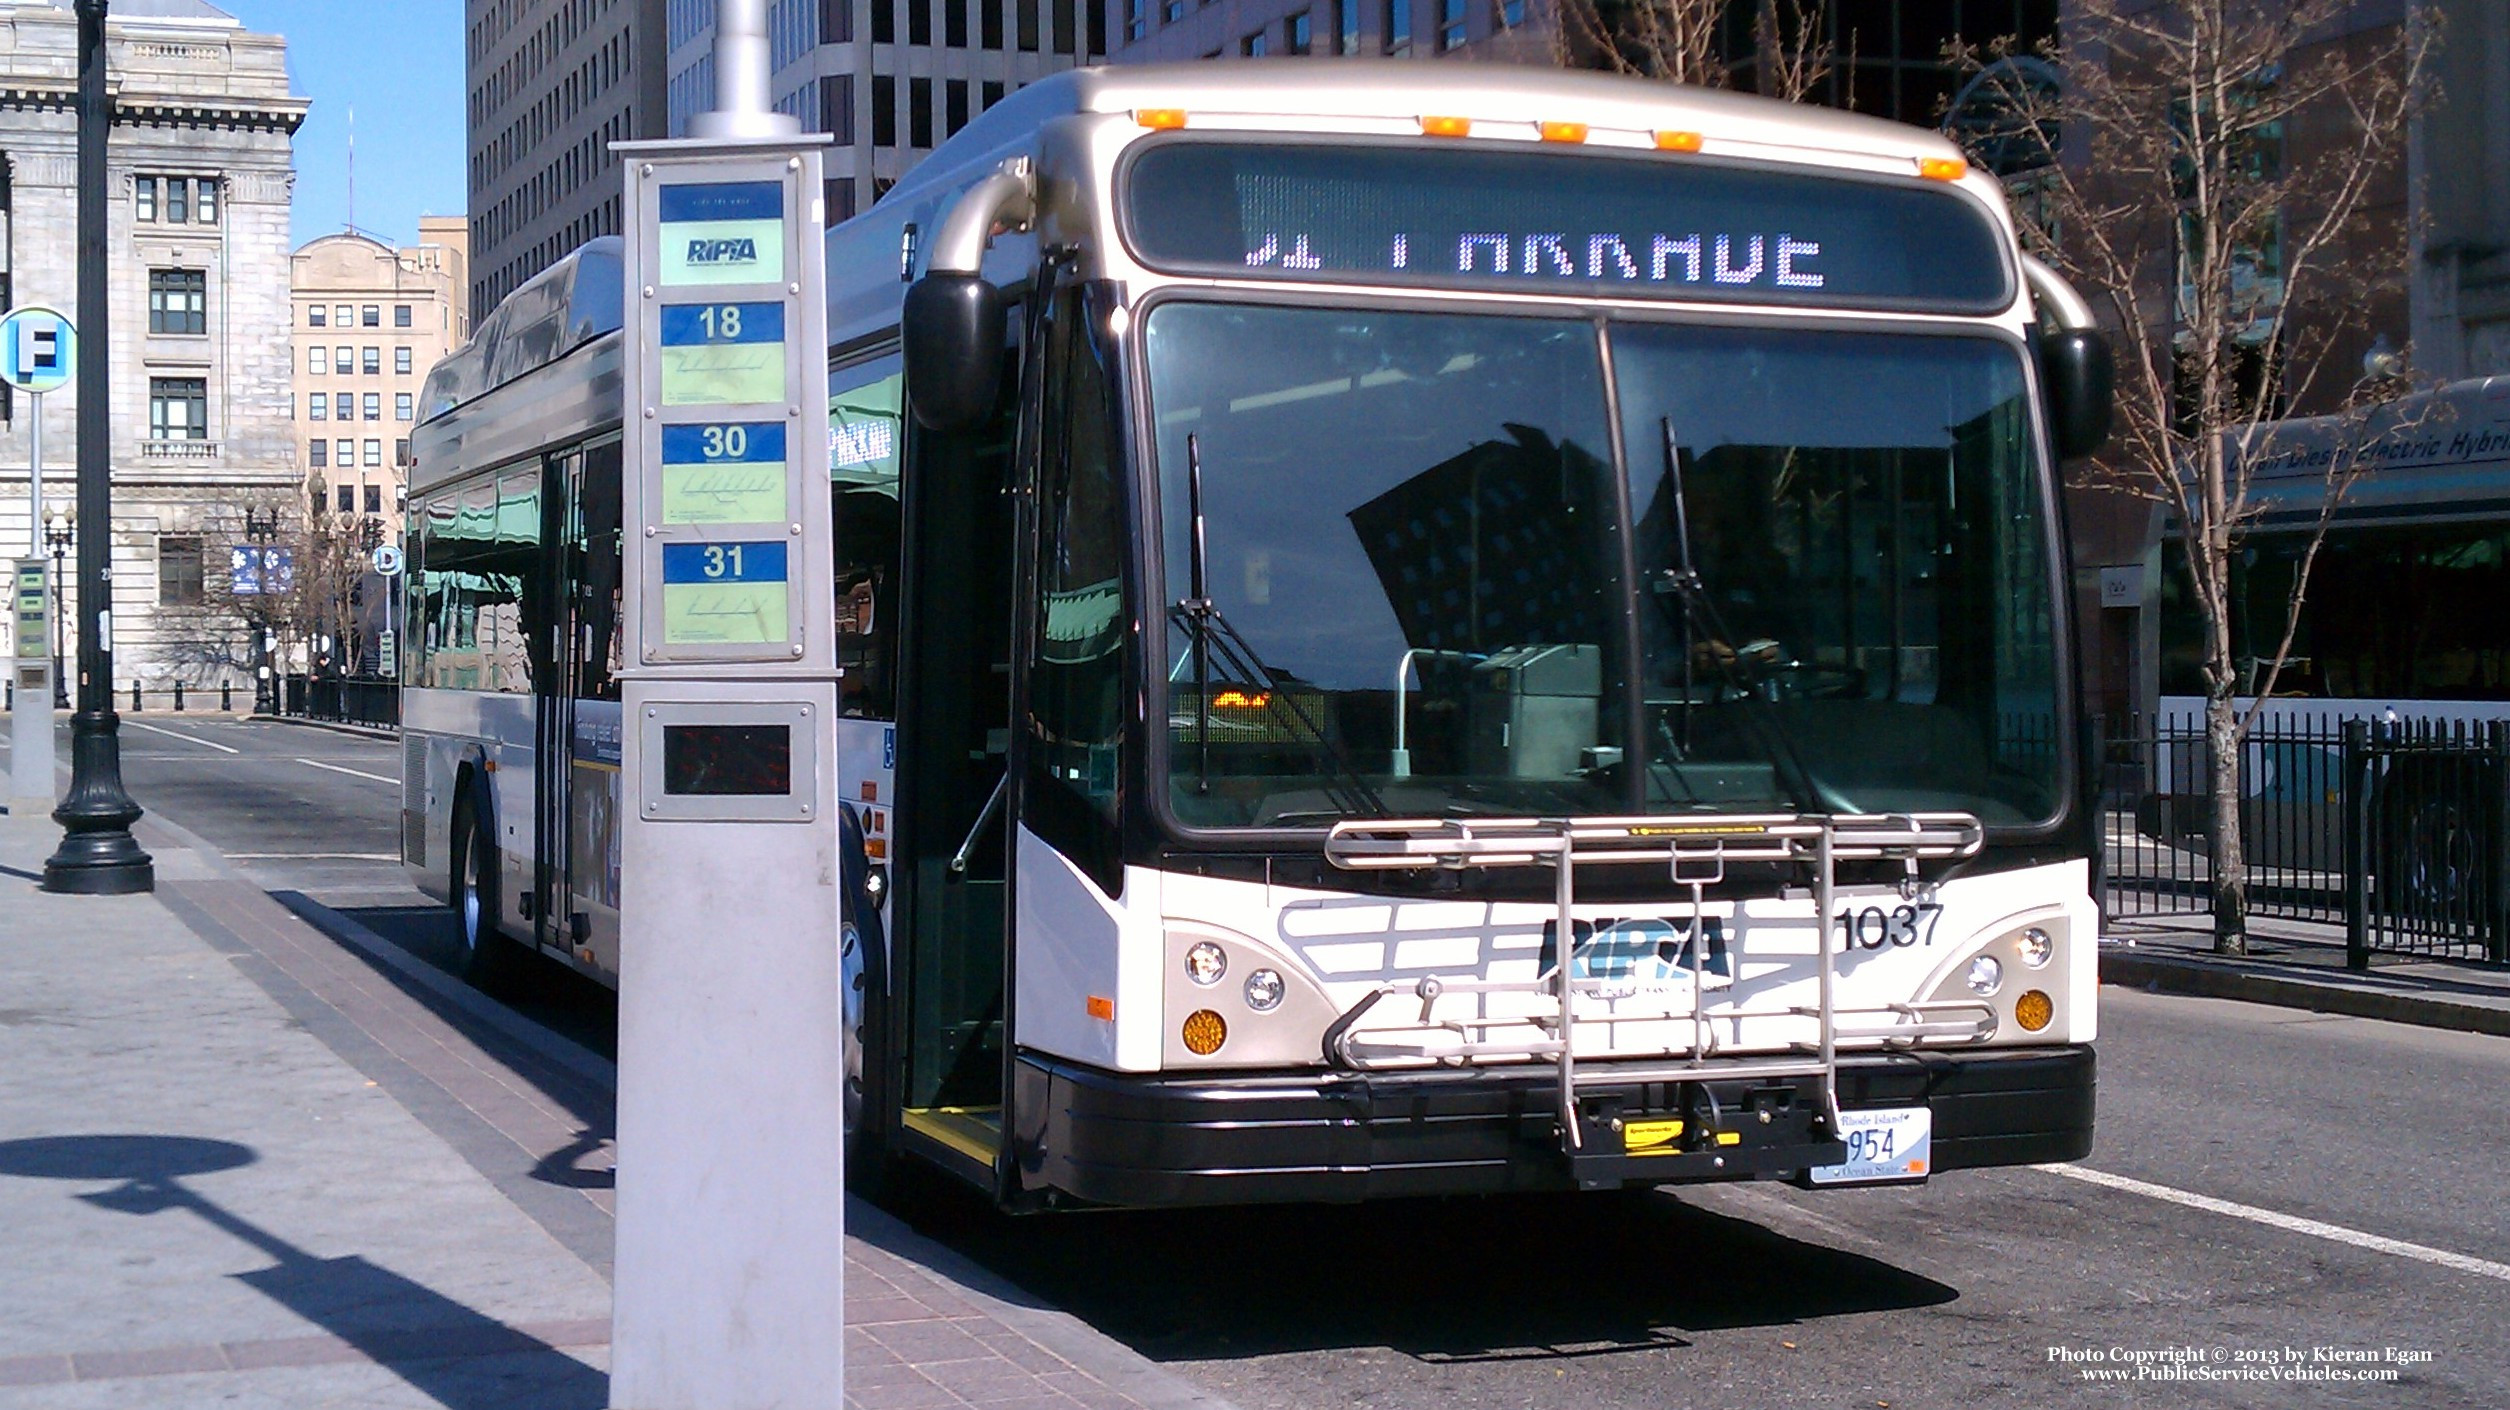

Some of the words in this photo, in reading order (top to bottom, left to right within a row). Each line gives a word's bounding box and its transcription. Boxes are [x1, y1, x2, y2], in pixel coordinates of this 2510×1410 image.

[686, 238, 757, 262] RIPTA
[699, 305, 743, 340] 18
[17, 319, 58, 373] F
[702, 425, 747, 458] 30
[2447, 429, 2510, 460] Hybri
[380, 551, 397, 572] D
[703, 544, 744, 578] 31
[1836, 903, 1945, 952] 1037
[1841, 1115, 1871, 1126] Rhode
[1874, 1112, 1905, 1125] Island
[1849, 1127, 1894, 1162] 954
